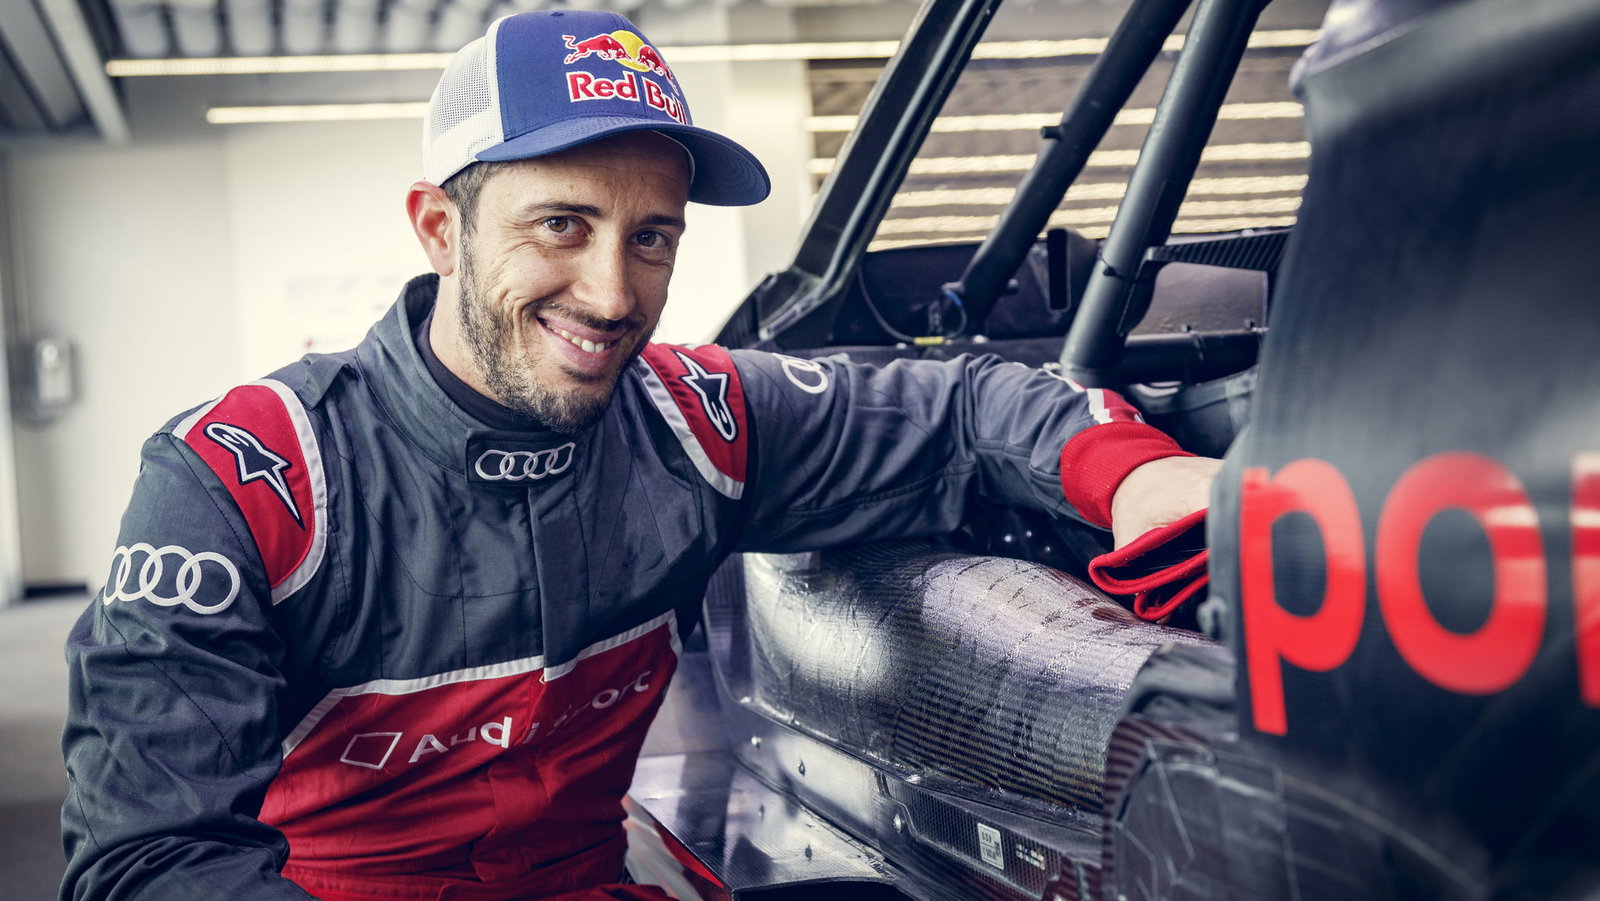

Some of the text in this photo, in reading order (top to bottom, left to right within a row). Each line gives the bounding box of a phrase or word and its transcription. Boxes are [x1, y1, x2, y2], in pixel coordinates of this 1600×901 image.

[567, 71, 688, 124] Red Bull
[408, 716, 540, 763] Audi
